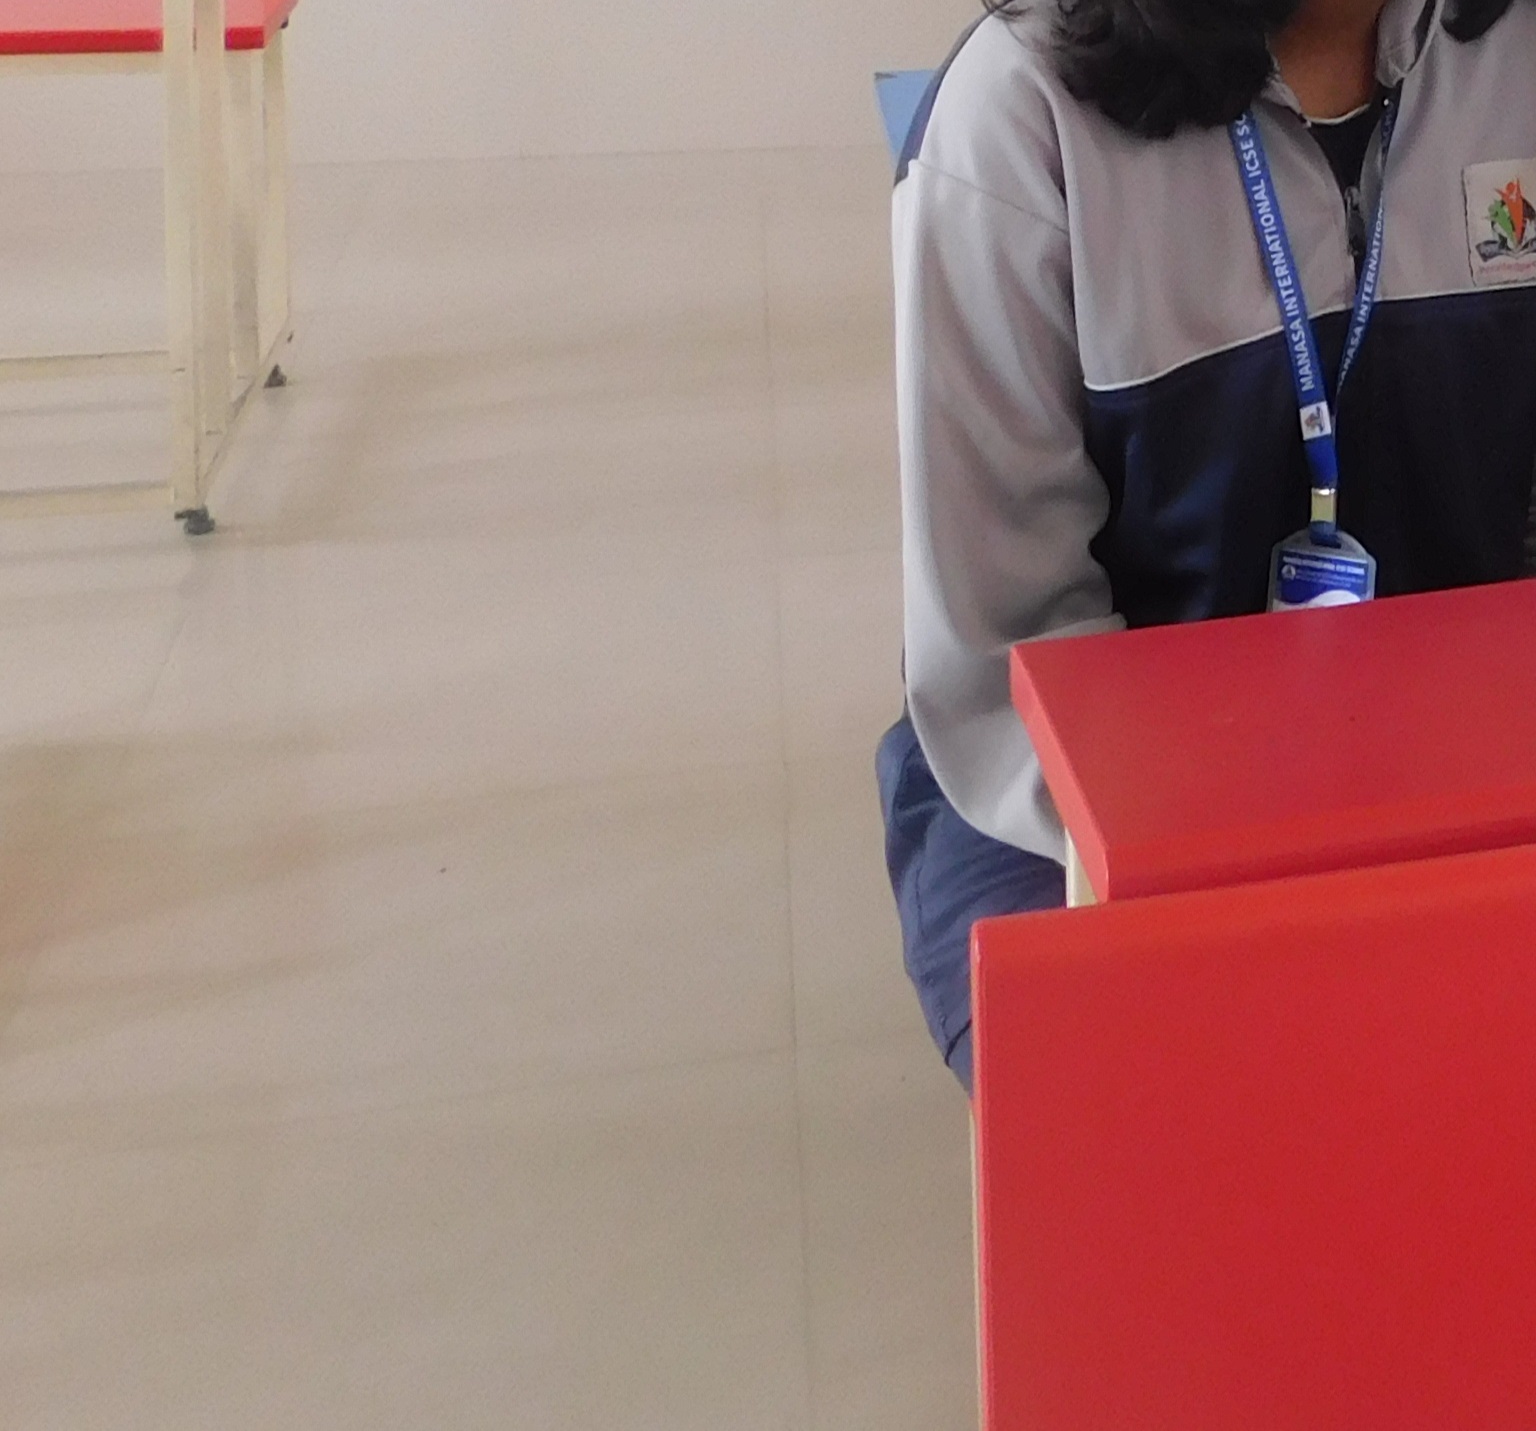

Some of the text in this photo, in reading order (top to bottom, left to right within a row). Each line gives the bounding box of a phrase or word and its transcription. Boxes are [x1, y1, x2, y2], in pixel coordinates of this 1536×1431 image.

[1240, 138, 1262, 179] ICSE
[1251, 178, 1300, 317] INTERNATIONAL
[1290, 317, 1315, 392] MANASA
